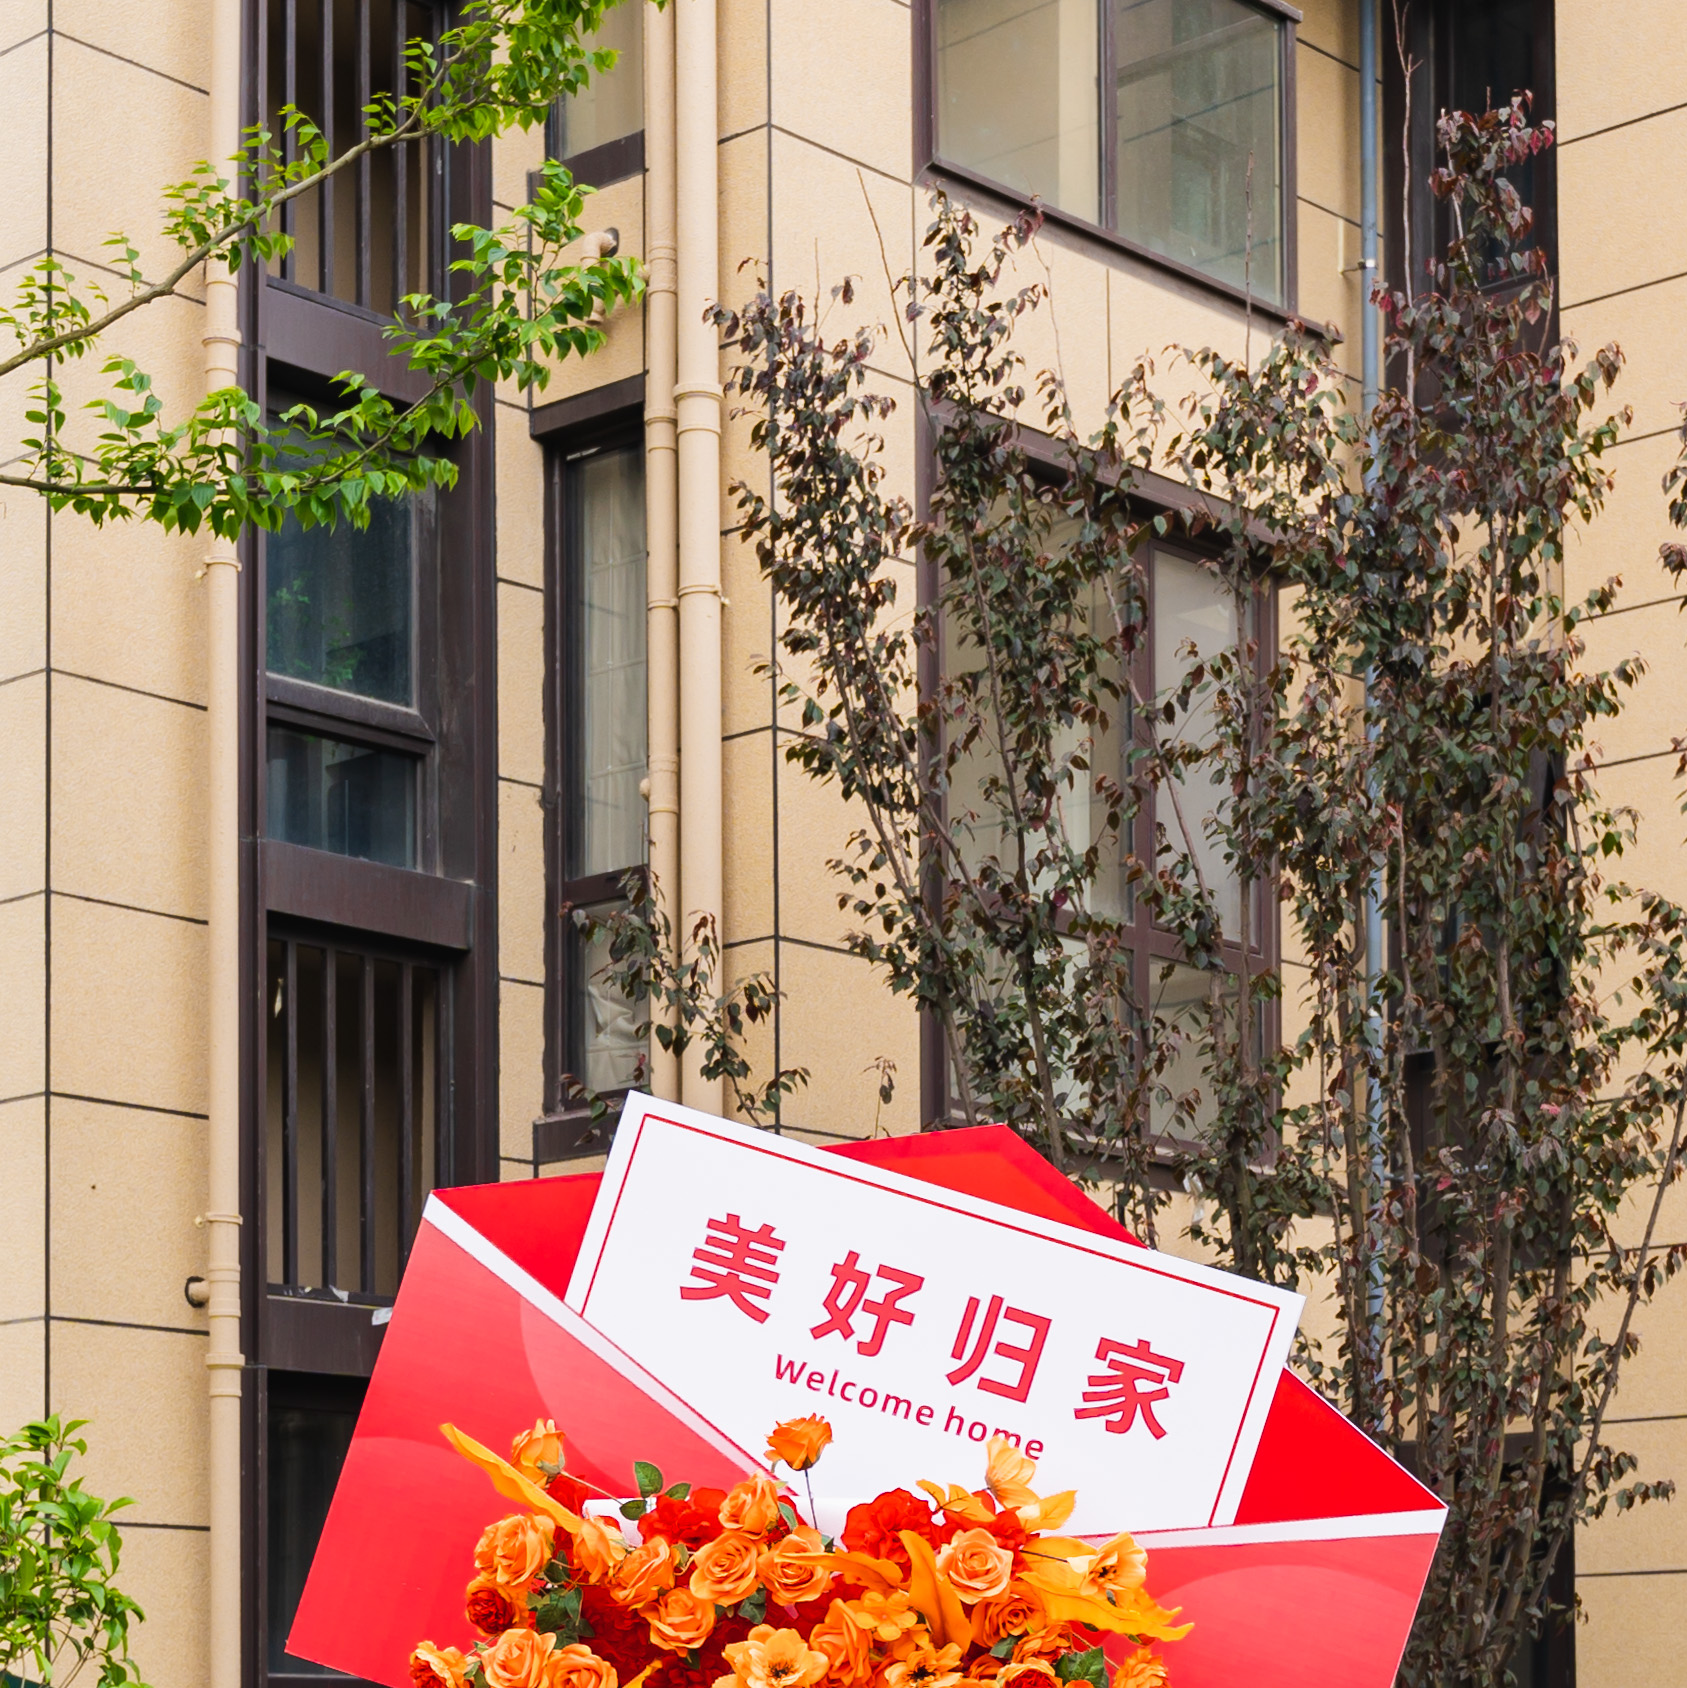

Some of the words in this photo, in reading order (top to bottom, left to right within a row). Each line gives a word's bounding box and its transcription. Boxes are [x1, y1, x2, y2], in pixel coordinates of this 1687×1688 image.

[680, 1213, 1185, 1441] 美好归家
[774, 1354, 935, 1427] Welcome
